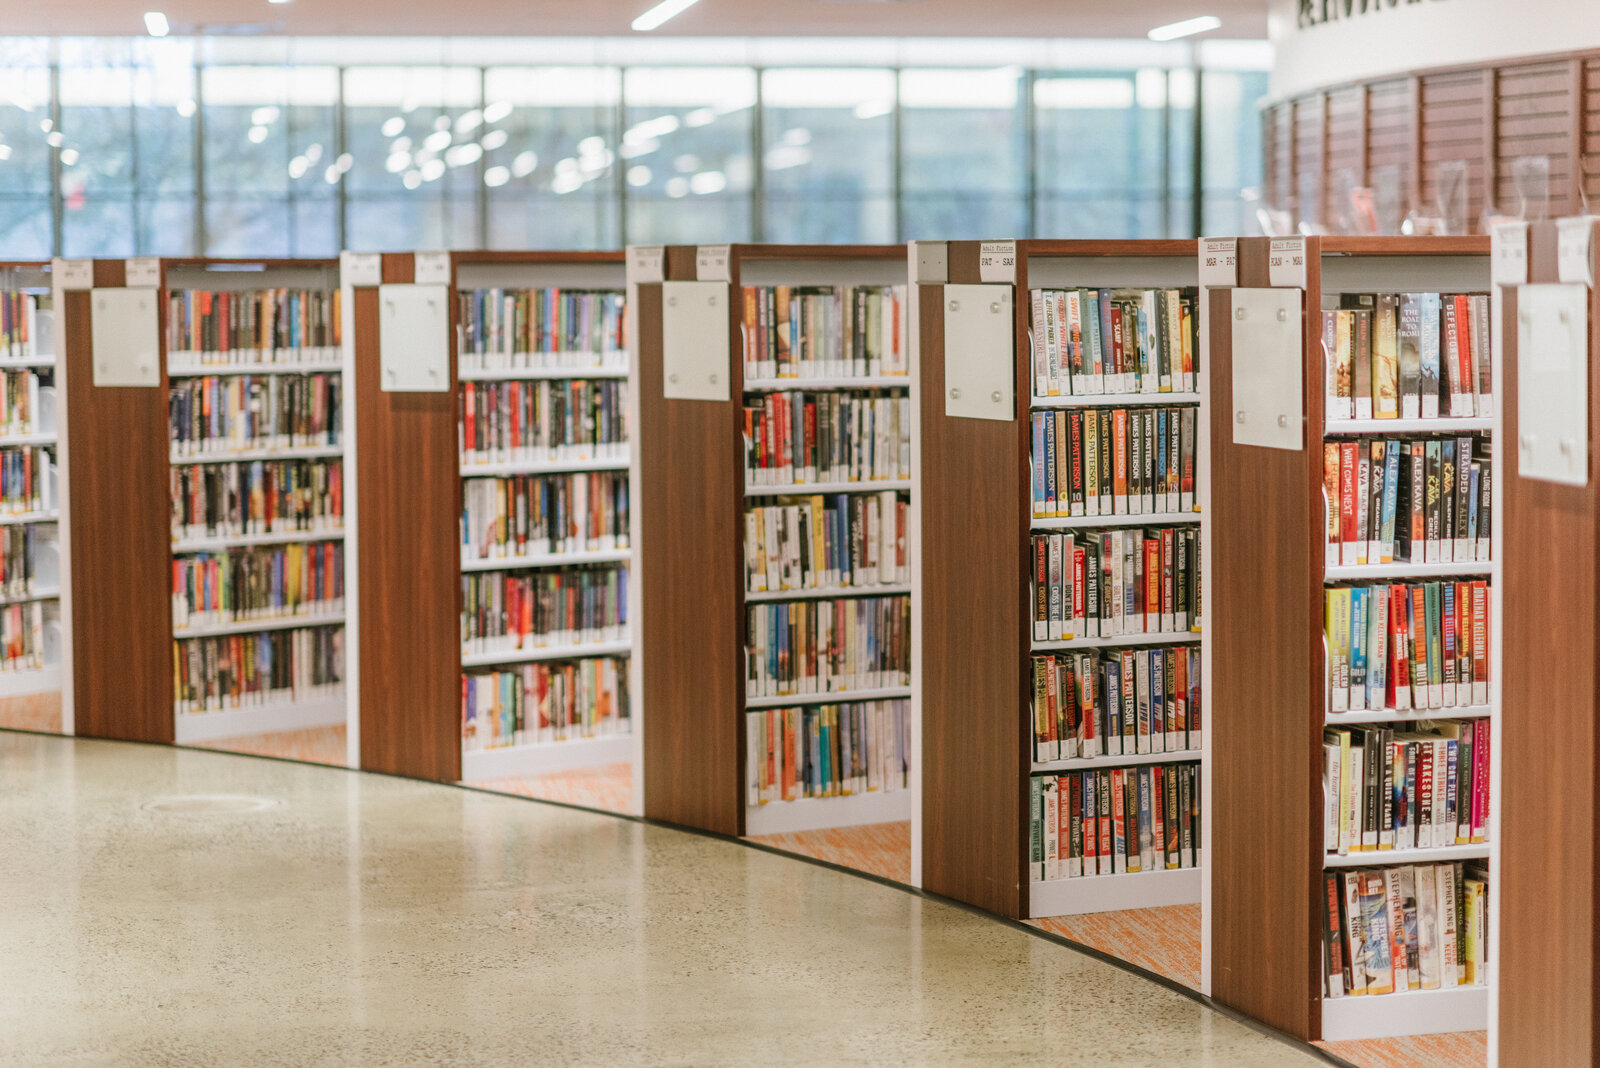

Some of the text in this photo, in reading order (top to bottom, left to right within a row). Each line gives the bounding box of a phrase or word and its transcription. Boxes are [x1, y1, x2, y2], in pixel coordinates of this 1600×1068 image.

[1206, 258, 1216, 266] MAR
[1036, 320, 1044, 355] MEASURE
[1070, 298, 1082, 366] SWIFT VENGEANCE
[1446, 304, 1456, 360] DEFECTORS
[1071, 416, 1081, 502] JAMES PATTERSON 10
[1460, 442, 1470, 493] STRANDED
[1104, 486, 1110, 494] 12
[1344, 448, 1352, 515] WHAT COMES NEXT
[1388, 486, 1396, 511] KAVA
[1039, 604, 1046, 612] MY
[1089, 579, 1097, 612] PATTERSON
[1445, 586, 1454, 683] JONATHAN KELLERMAN MYSTE
[1474, 588, 1484, 660] JONATHAN KELLERMAN
[1036, 662, 1046, 686] JAMES
[1154, 654, 1162, 670] JAMES
[1124, 656, 1134, 724] JAMES PATTERSON
[1067, 692, 1075, 726] PATTERSON
[1140, 702, 1148, 722] NYPD
[1448, 746, 1456, 762] TWO
[1168, 770, 1176, 788] JAMES
[1422, 745, 1432, 812] IT TAKES ONE
[1436, 772, 1446, 802] STRIKES
[1390, 874, 1403, 936] STEPHEN KING
[1444, 872, 1452, 906] STEPHEN
[1371, 918, 1380, 941] KING
[1378, 918, 1388, 958] STEPHEN
[1402, 958, 1406, 966] OF
